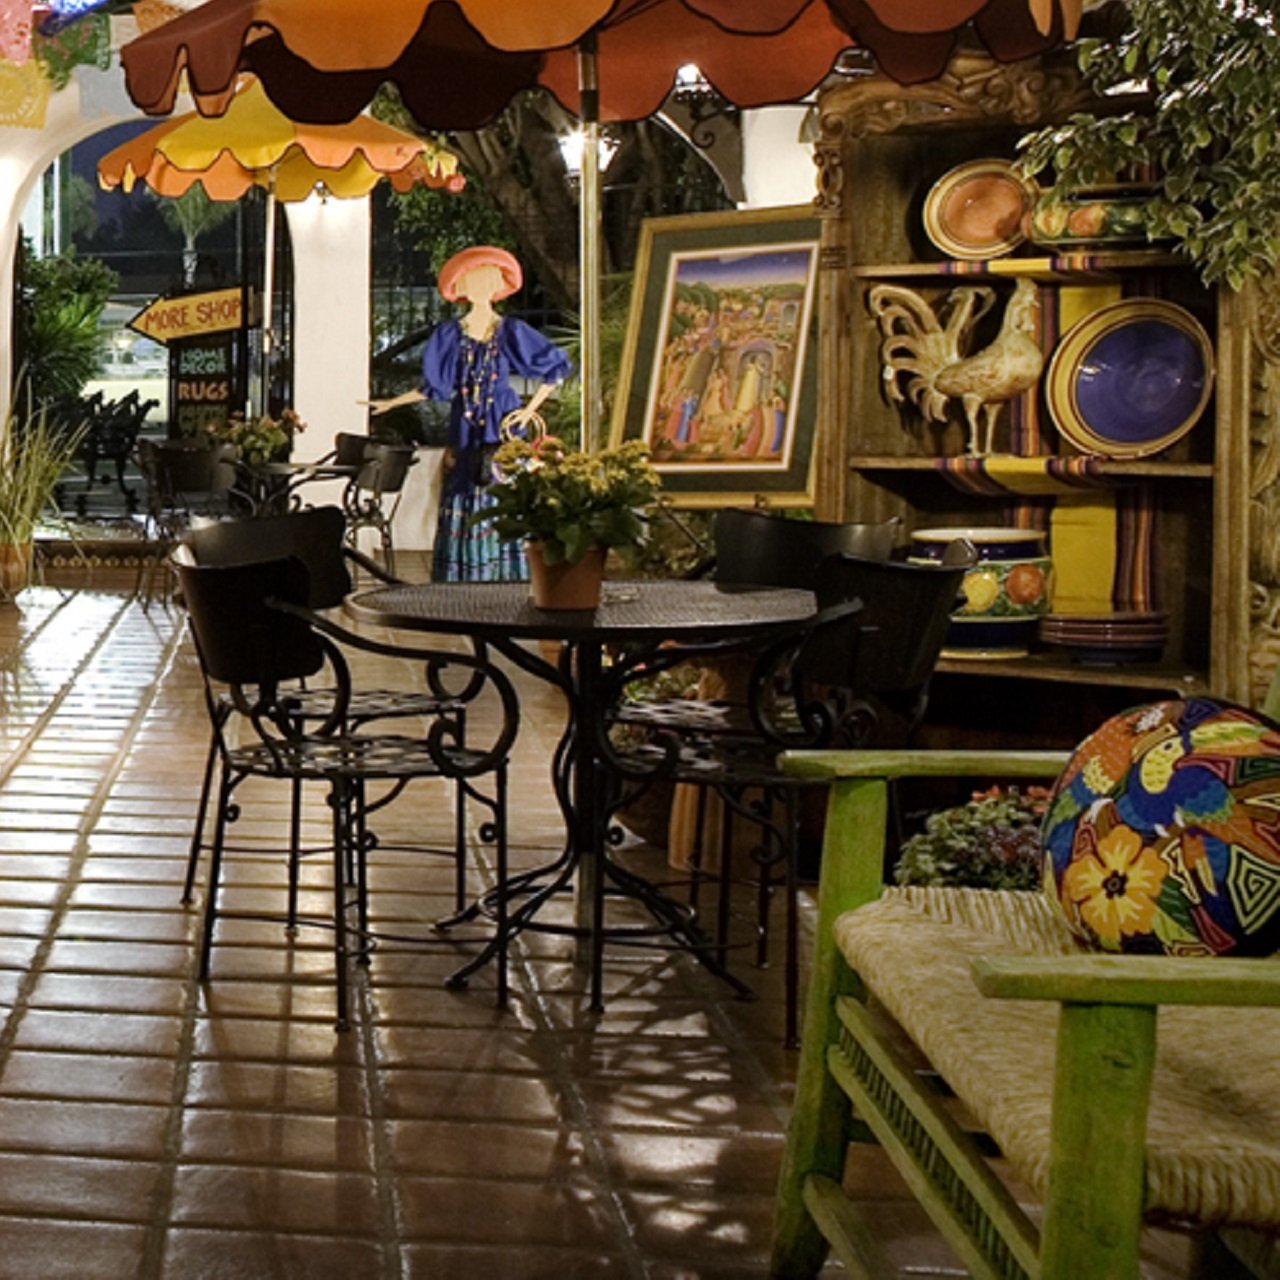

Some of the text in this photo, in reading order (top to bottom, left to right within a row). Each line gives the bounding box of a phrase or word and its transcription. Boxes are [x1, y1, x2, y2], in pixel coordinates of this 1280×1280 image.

[143, 304, 190, 331] MORE
[180, 347, 226, 362] HOME
[179, 361, 227, 375] DECOR
[178, 381, 229, 401] RUGS
